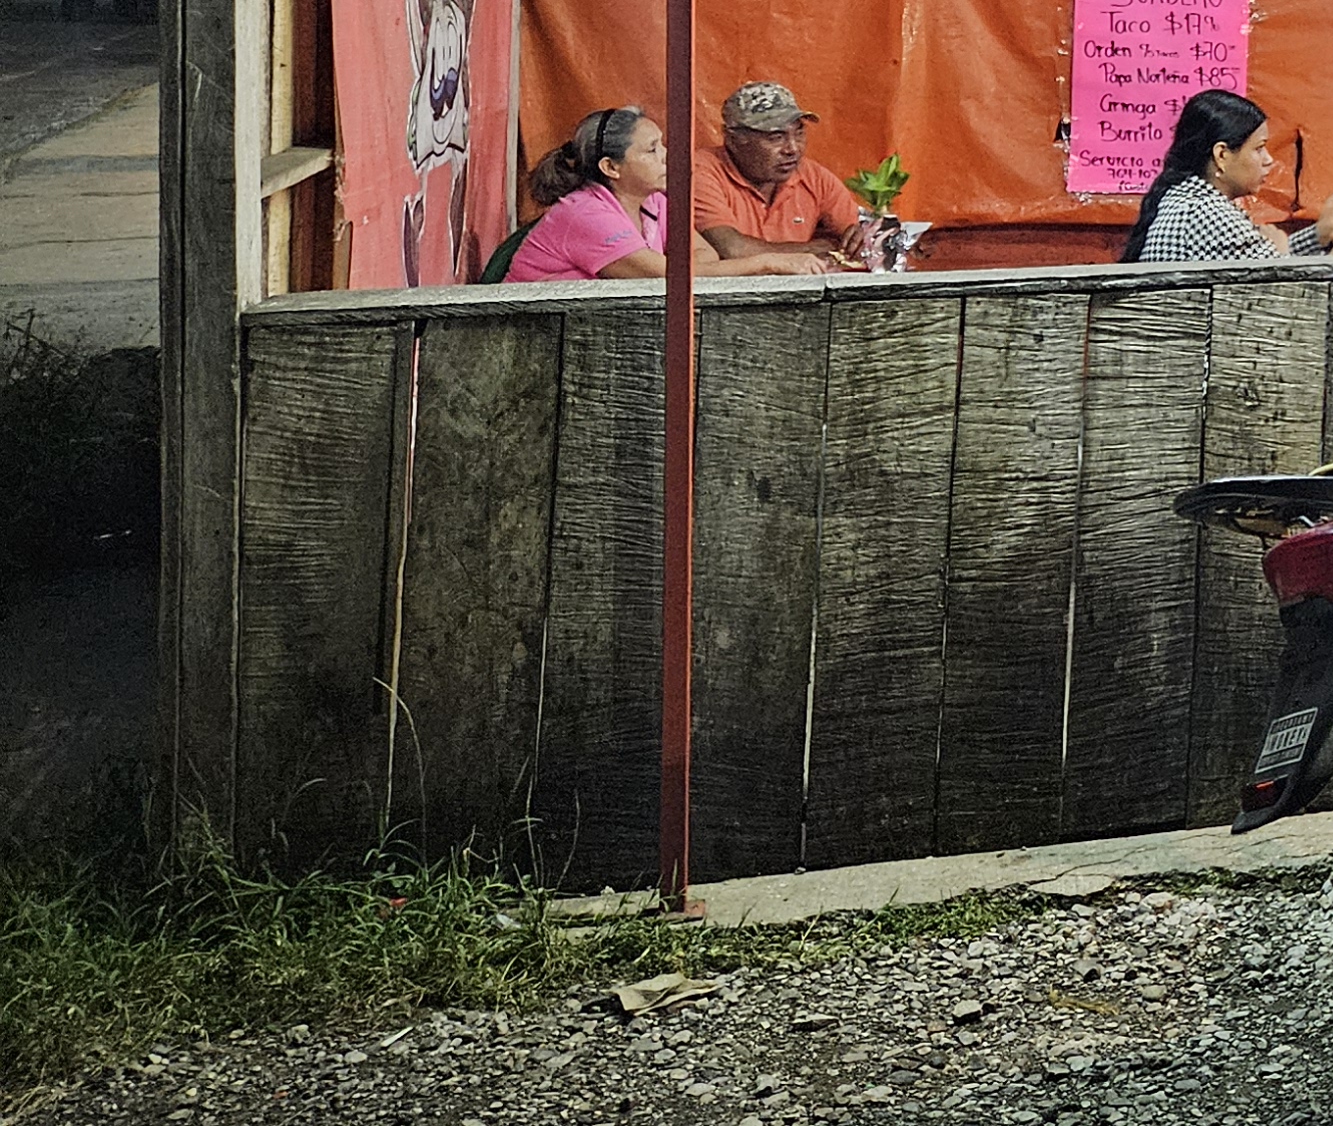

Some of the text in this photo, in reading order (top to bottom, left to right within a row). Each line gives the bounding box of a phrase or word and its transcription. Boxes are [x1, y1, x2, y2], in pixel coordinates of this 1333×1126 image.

[1100, 11, 1151, 34] Taco
[1084, 40, 1132, 58] Orden
[1098, 62, 1132, 87] Papa
[1098, 121, 1163, 142] Burrito
[1080, 149, 1144, 167] Servicio
